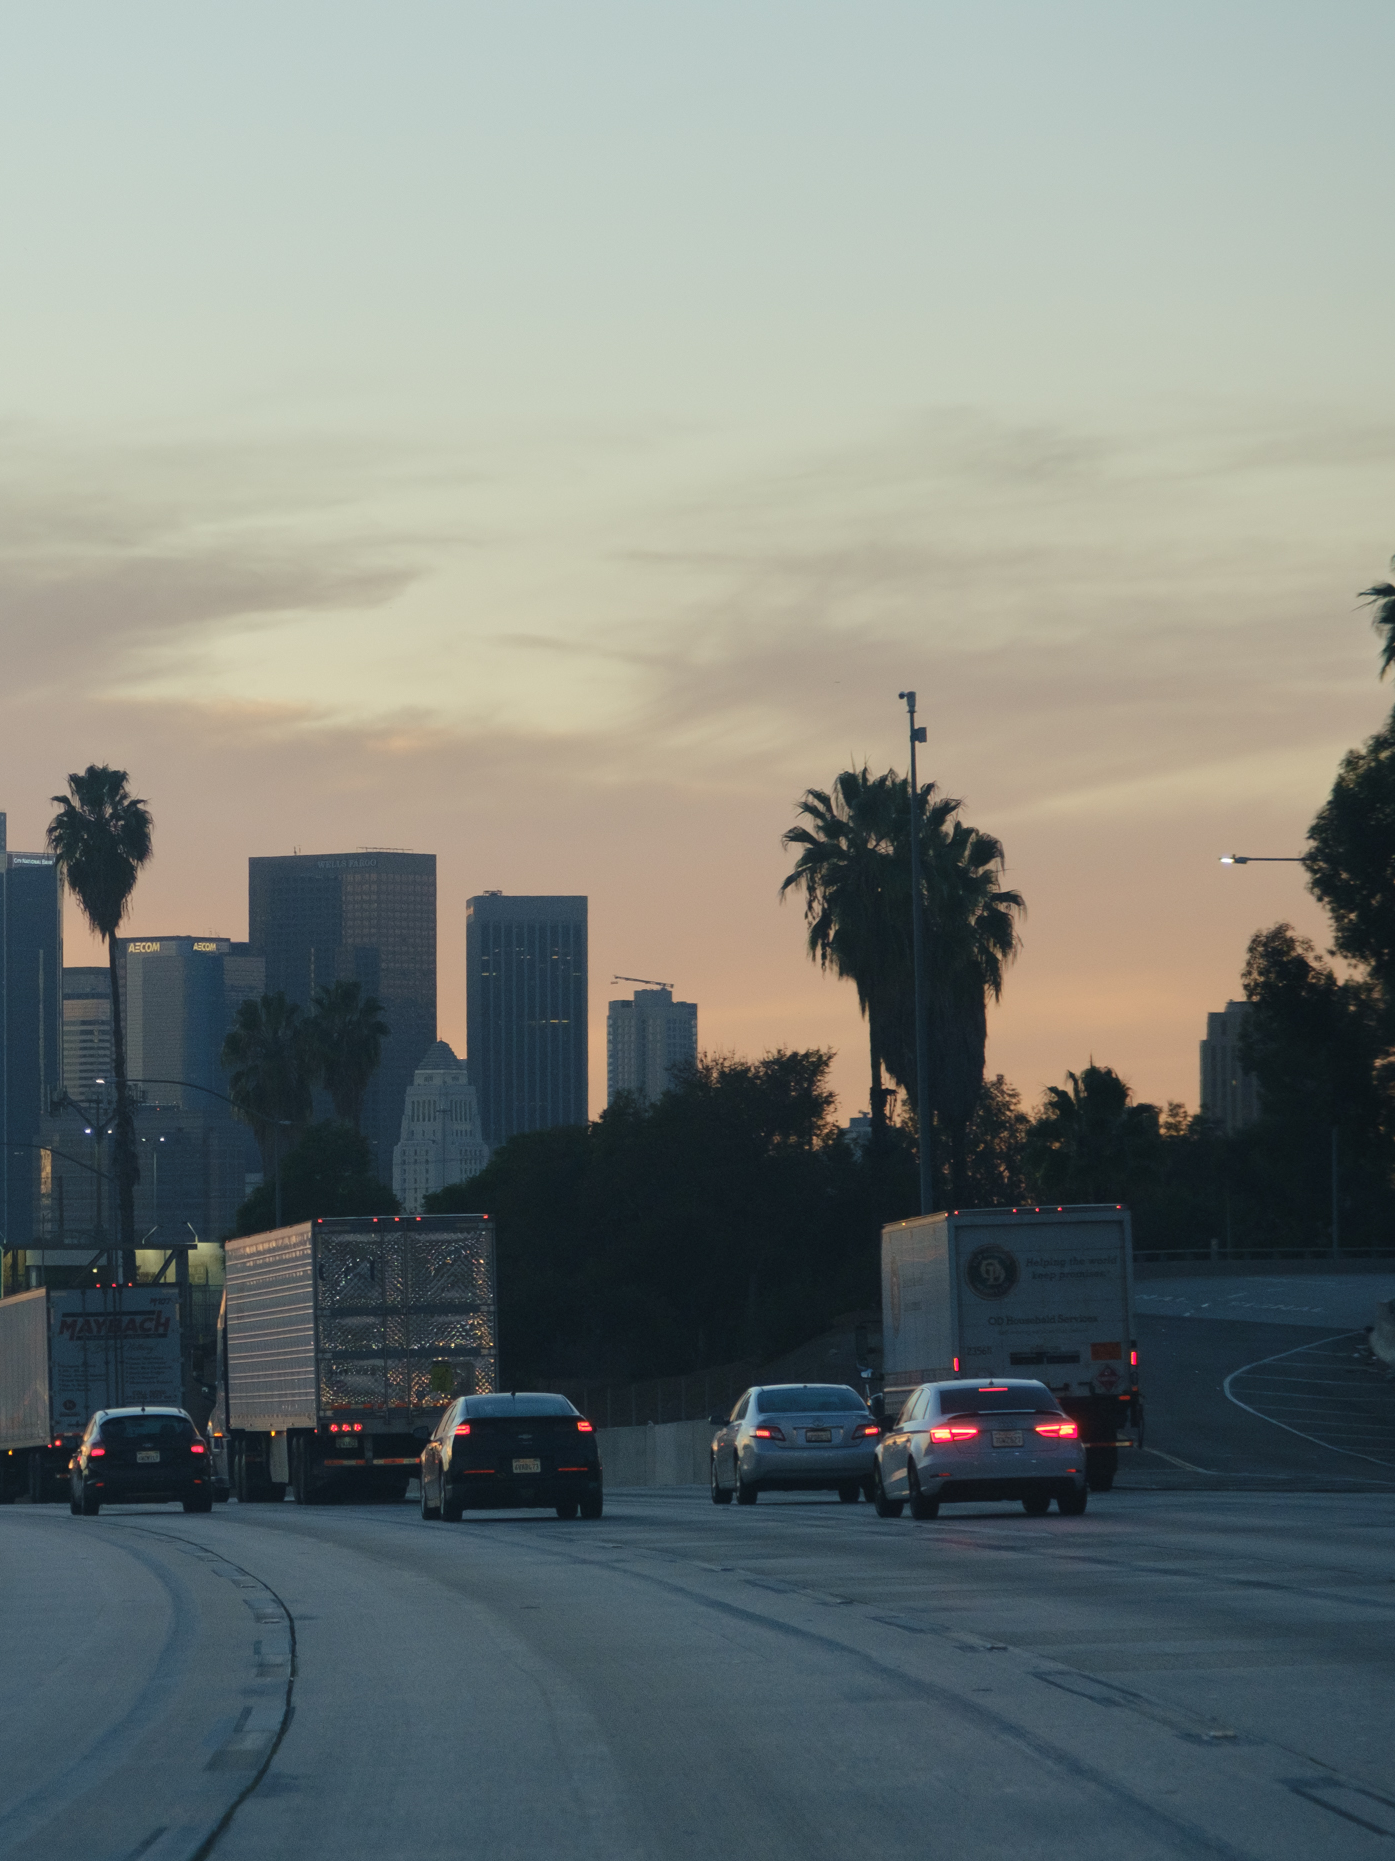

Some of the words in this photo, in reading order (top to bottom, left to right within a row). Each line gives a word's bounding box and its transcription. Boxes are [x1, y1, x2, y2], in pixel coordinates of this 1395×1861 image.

[317, 860, 346, 868] WELLS
[348, 859, 376, 868] FARGO
[128, 942, 160, 953] AECOM
[193, 942, 217, 952] AECOM
[1026, 1257, 1066, 1268] Helping
[1070, 1256, 1085, 1265] the
[1088, 1255, 1117, 1265] world
[1032, 1271, 1056, 1281] keep
[59, 1310, 170, 1340] MAYBACH
[988, 1316, 1004, 1325] OD
[1006, 1315, 1055, 1325] Household
[1058, 1315, 1098, 1324] Services
